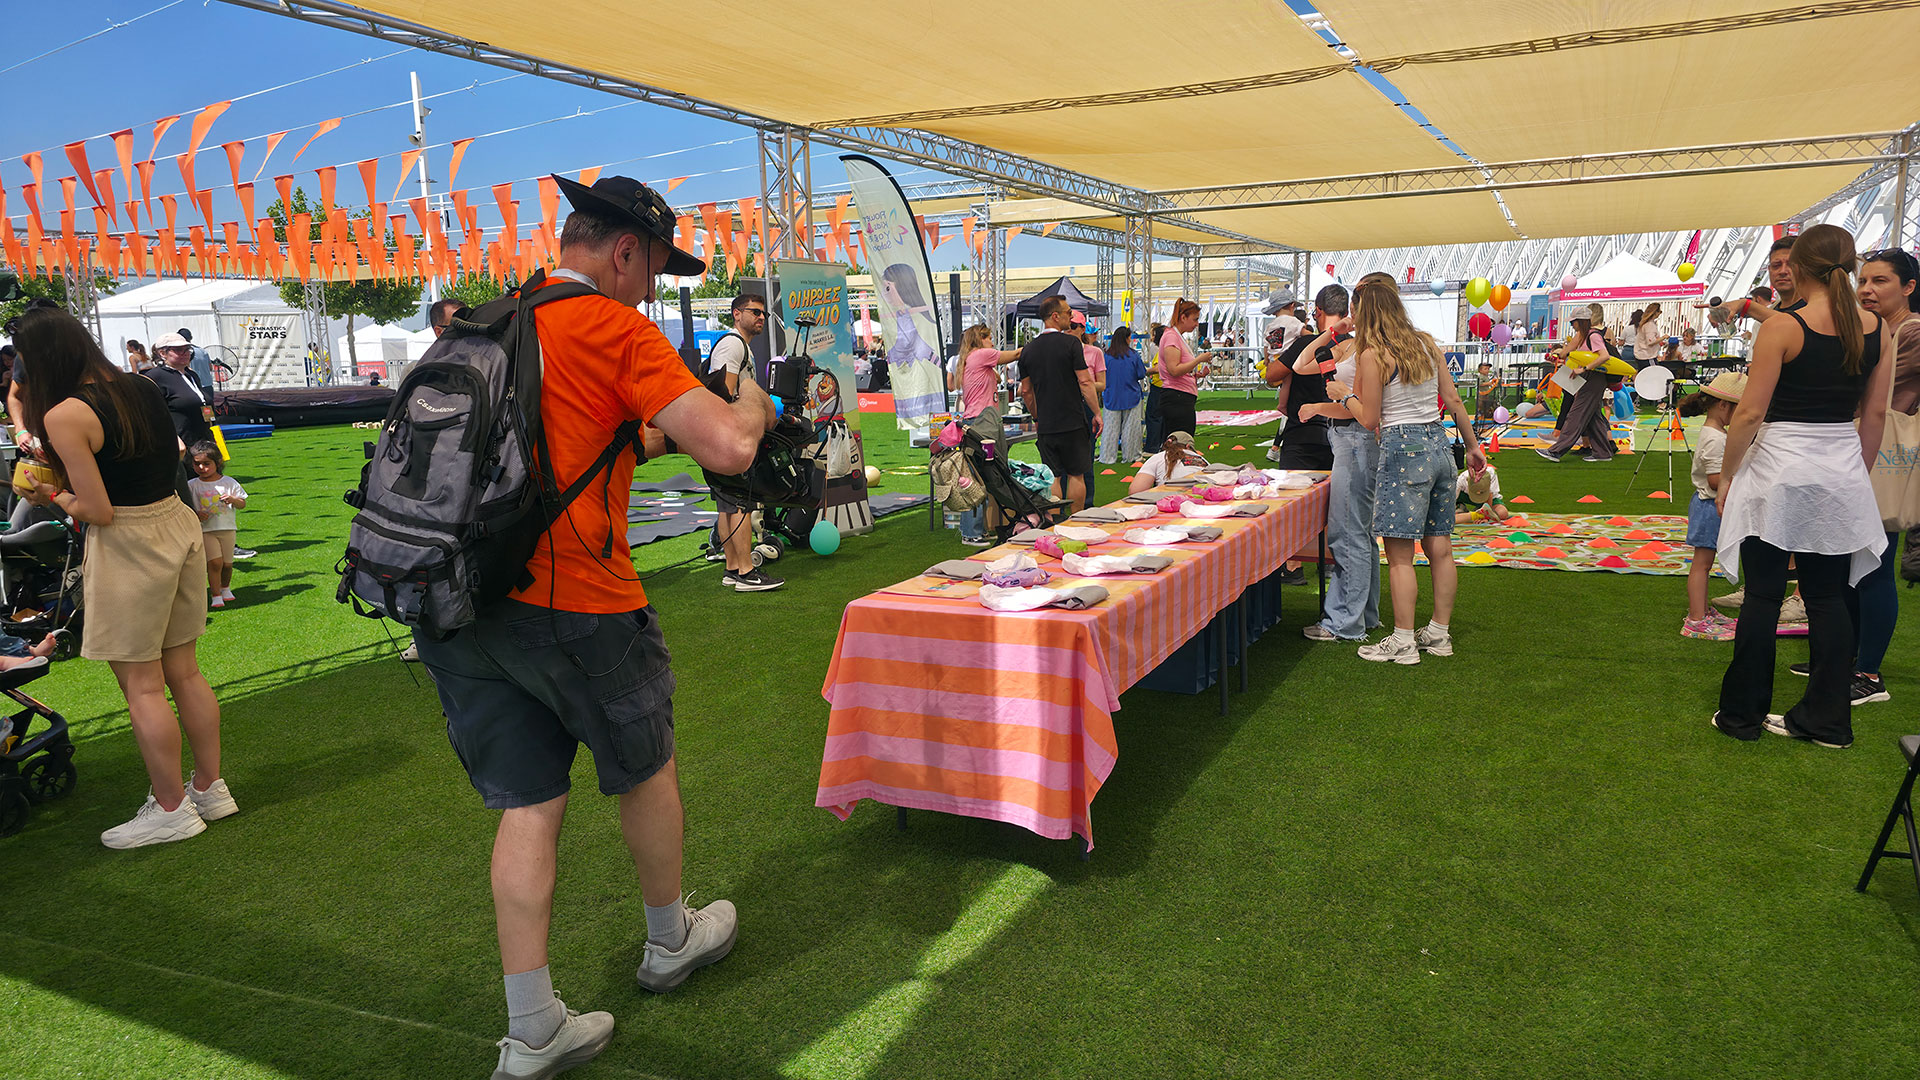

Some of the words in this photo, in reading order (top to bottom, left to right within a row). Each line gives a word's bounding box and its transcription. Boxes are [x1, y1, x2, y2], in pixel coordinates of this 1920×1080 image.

[815, 304, 840, 326] ΛΙΟ
[249, 331, 287, 339] STARS
[1892, 443, 1919, 455] The
